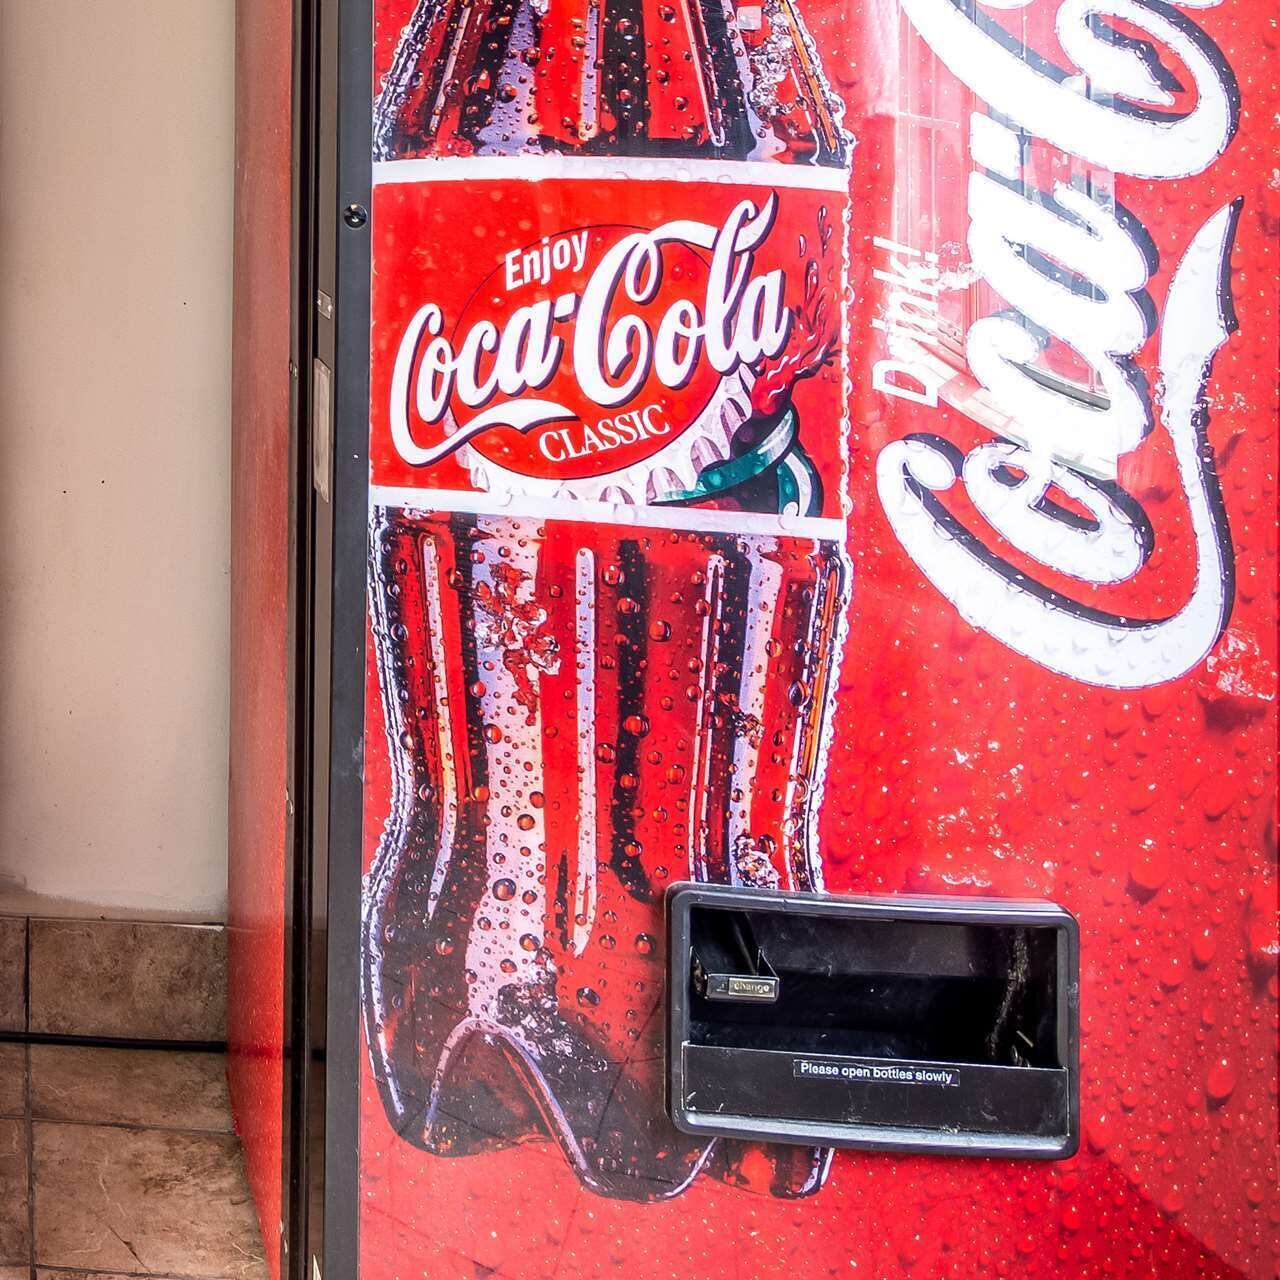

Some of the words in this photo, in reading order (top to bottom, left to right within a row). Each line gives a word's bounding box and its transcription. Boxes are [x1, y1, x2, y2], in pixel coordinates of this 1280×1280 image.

[504, 229, 590, 292] Enjoy
[389, 189, 794, 468] Coca-Cola
[538, 403, 673, 463] CLASSIC
[733, 981, 770, 994] change
[800, 1062, 840, 1075] Please
[841, 1066, 871, 1079] open
[873, 1067, 913, 1080] bottles
[915, 1070, 953, 1084] slowly
